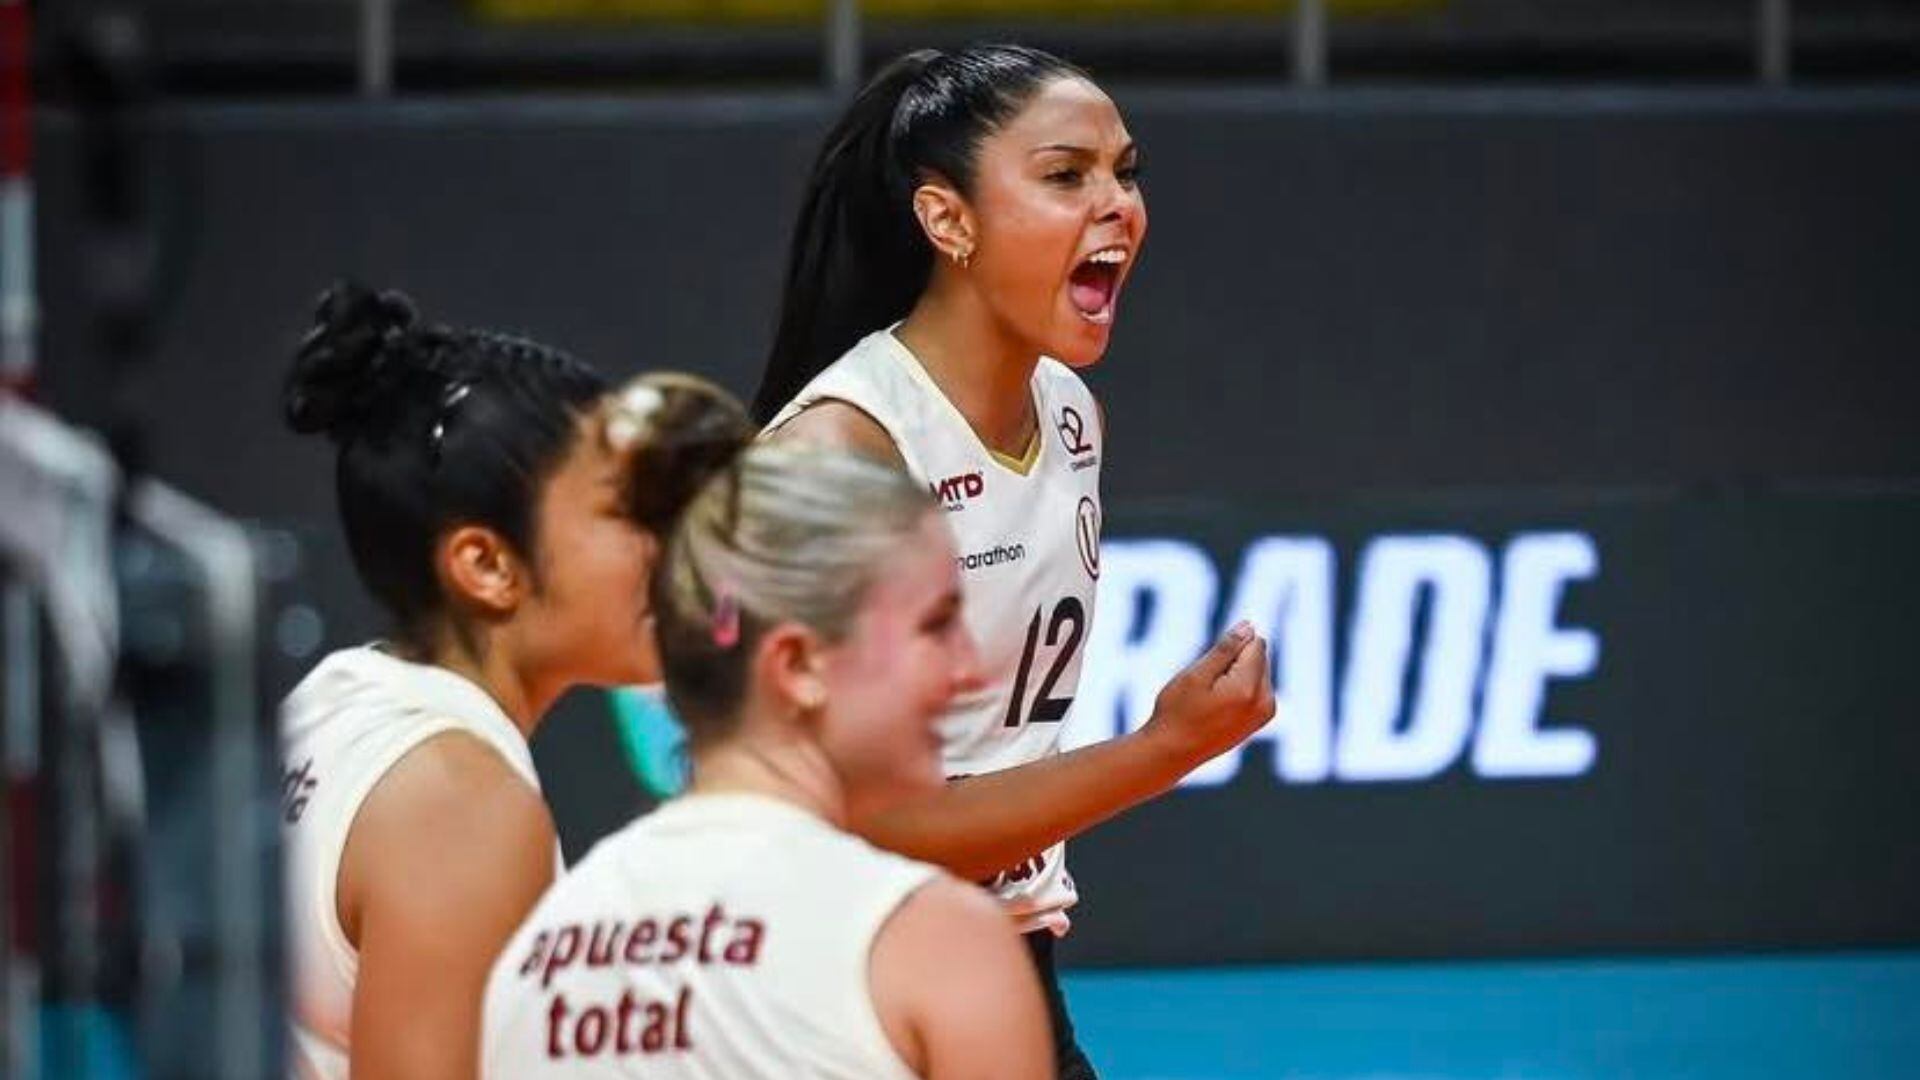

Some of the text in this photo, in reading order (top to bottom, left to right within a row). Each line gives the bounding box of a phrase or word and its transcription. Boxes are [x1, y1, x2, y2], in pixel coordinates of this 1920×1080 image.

[1004, 596, 1085, 727] 12
[519, 902, 766, 988] apuesta
[548, 984, 693, 1058] total
